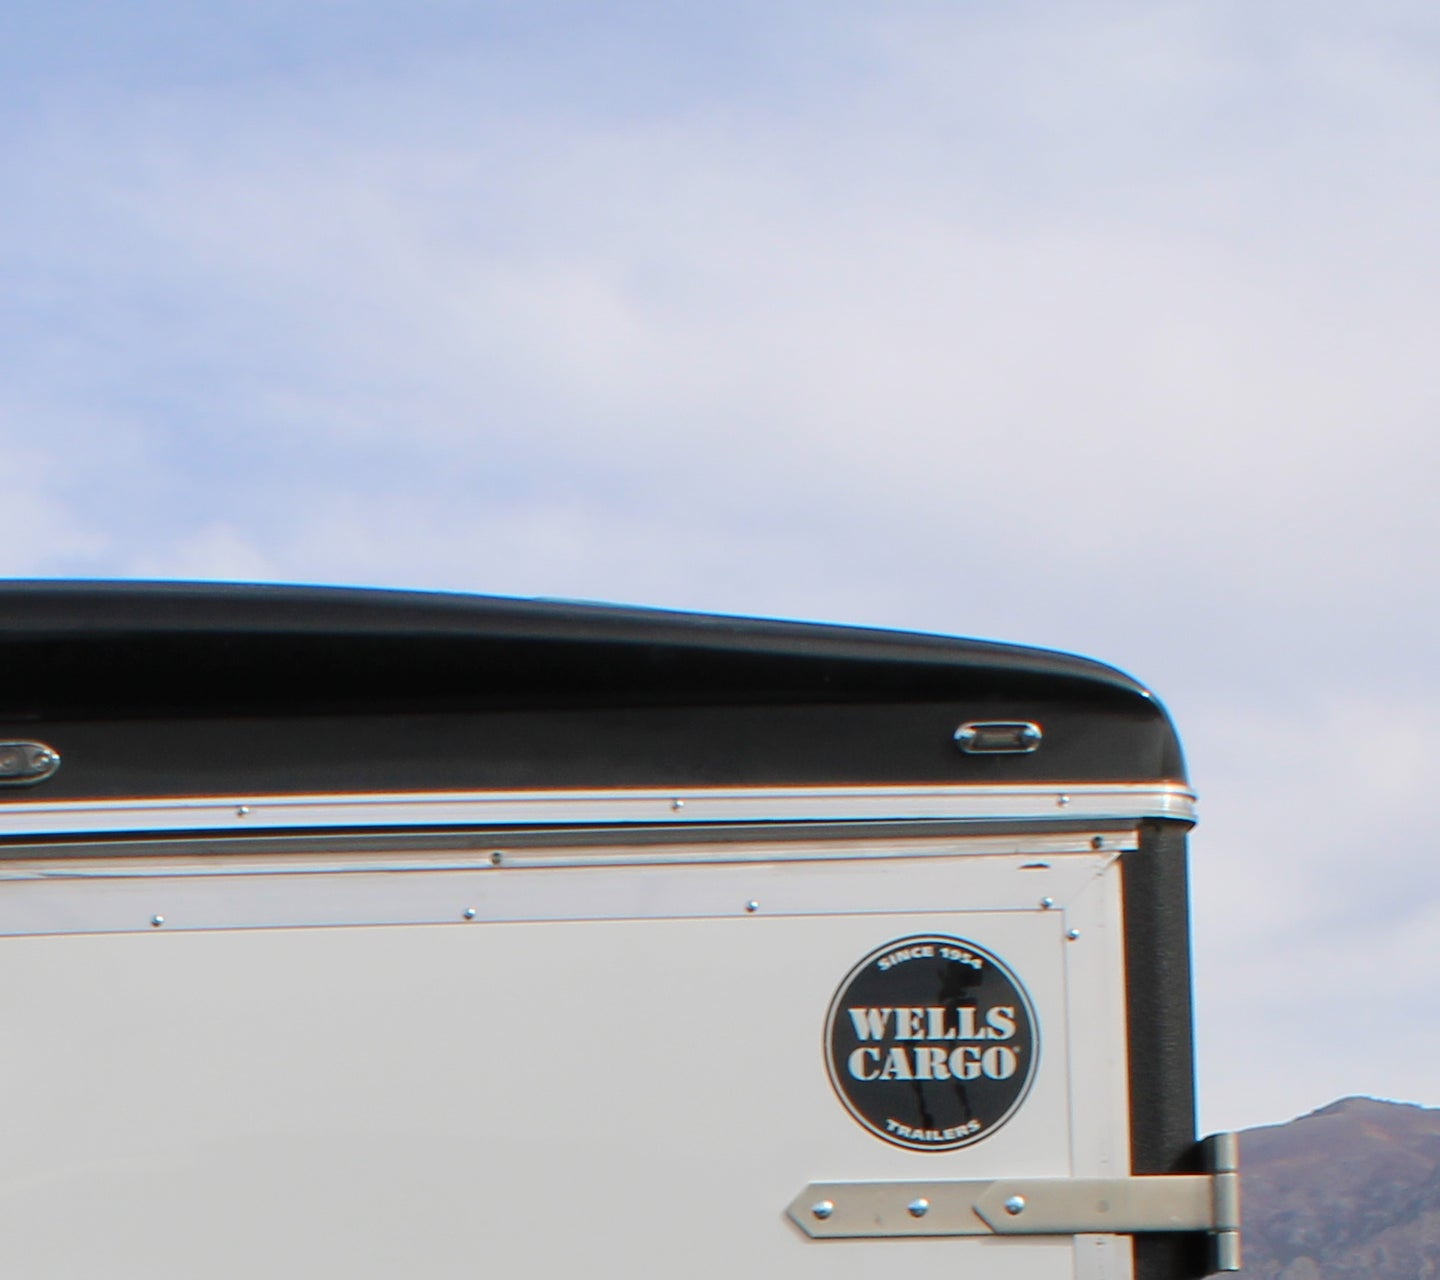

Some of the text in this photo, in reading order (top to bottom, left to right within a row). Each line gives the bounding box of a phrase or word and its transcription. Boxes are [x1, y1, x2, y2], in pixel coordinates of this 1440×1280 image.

[877, 946, 983, 971] SINCE 1954
[848, 1006, 1016, 1041] WELLS
[848, 1046, 1018, 1081] CARGO
[886, 1119, 981, 1141] TRAILERS
